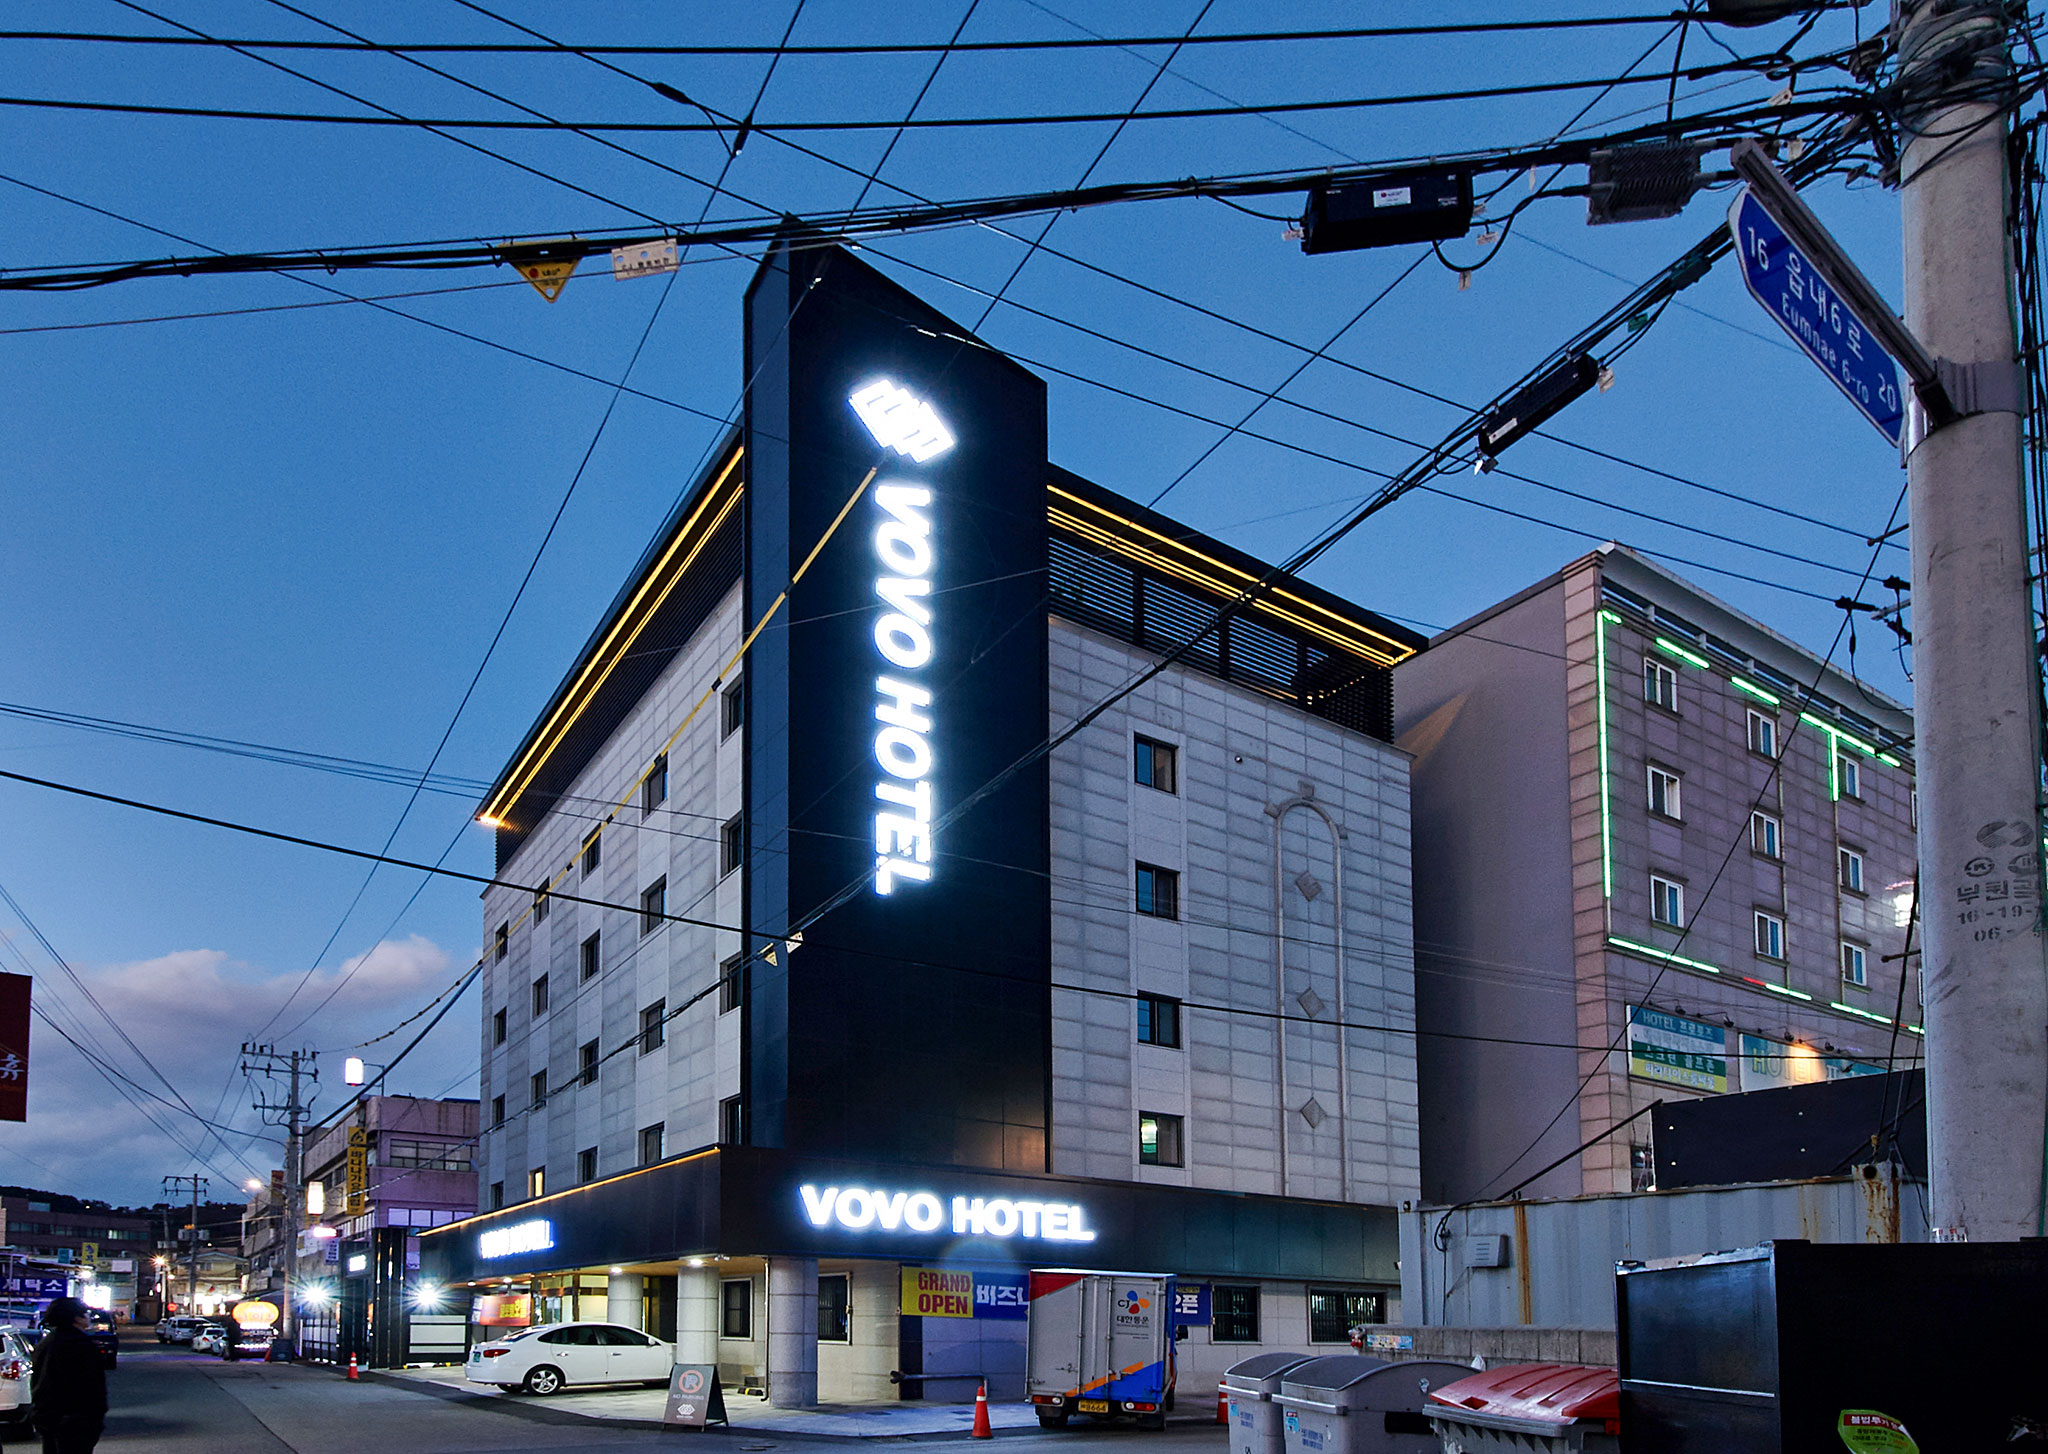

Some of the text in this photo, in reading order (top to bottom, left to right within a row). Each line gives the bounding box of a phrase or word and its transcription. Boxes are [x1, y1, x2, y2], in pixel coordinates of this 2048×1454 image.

[1747, 226, 1769, 272] 16
[1784, 251, 1864, 361] 읍내6로
[1781, 291, 1870, 405] Eumnae 6-ro
[1877, 372, 1897, 413] 20
[873, 484, 933, 897] VOVO HOTEL
[1642, 1012, 1676, 1031] HOTEL
[798, 1184, 1095, 1241] VOVO HOTEL
[2, 1279, 63, 1292] 세탁소
[918, 1271, 971, 1293] GRAND
[918, 1293, 968, 1314] OPEN
[1117, 1299, 1131, 1309] CJ
